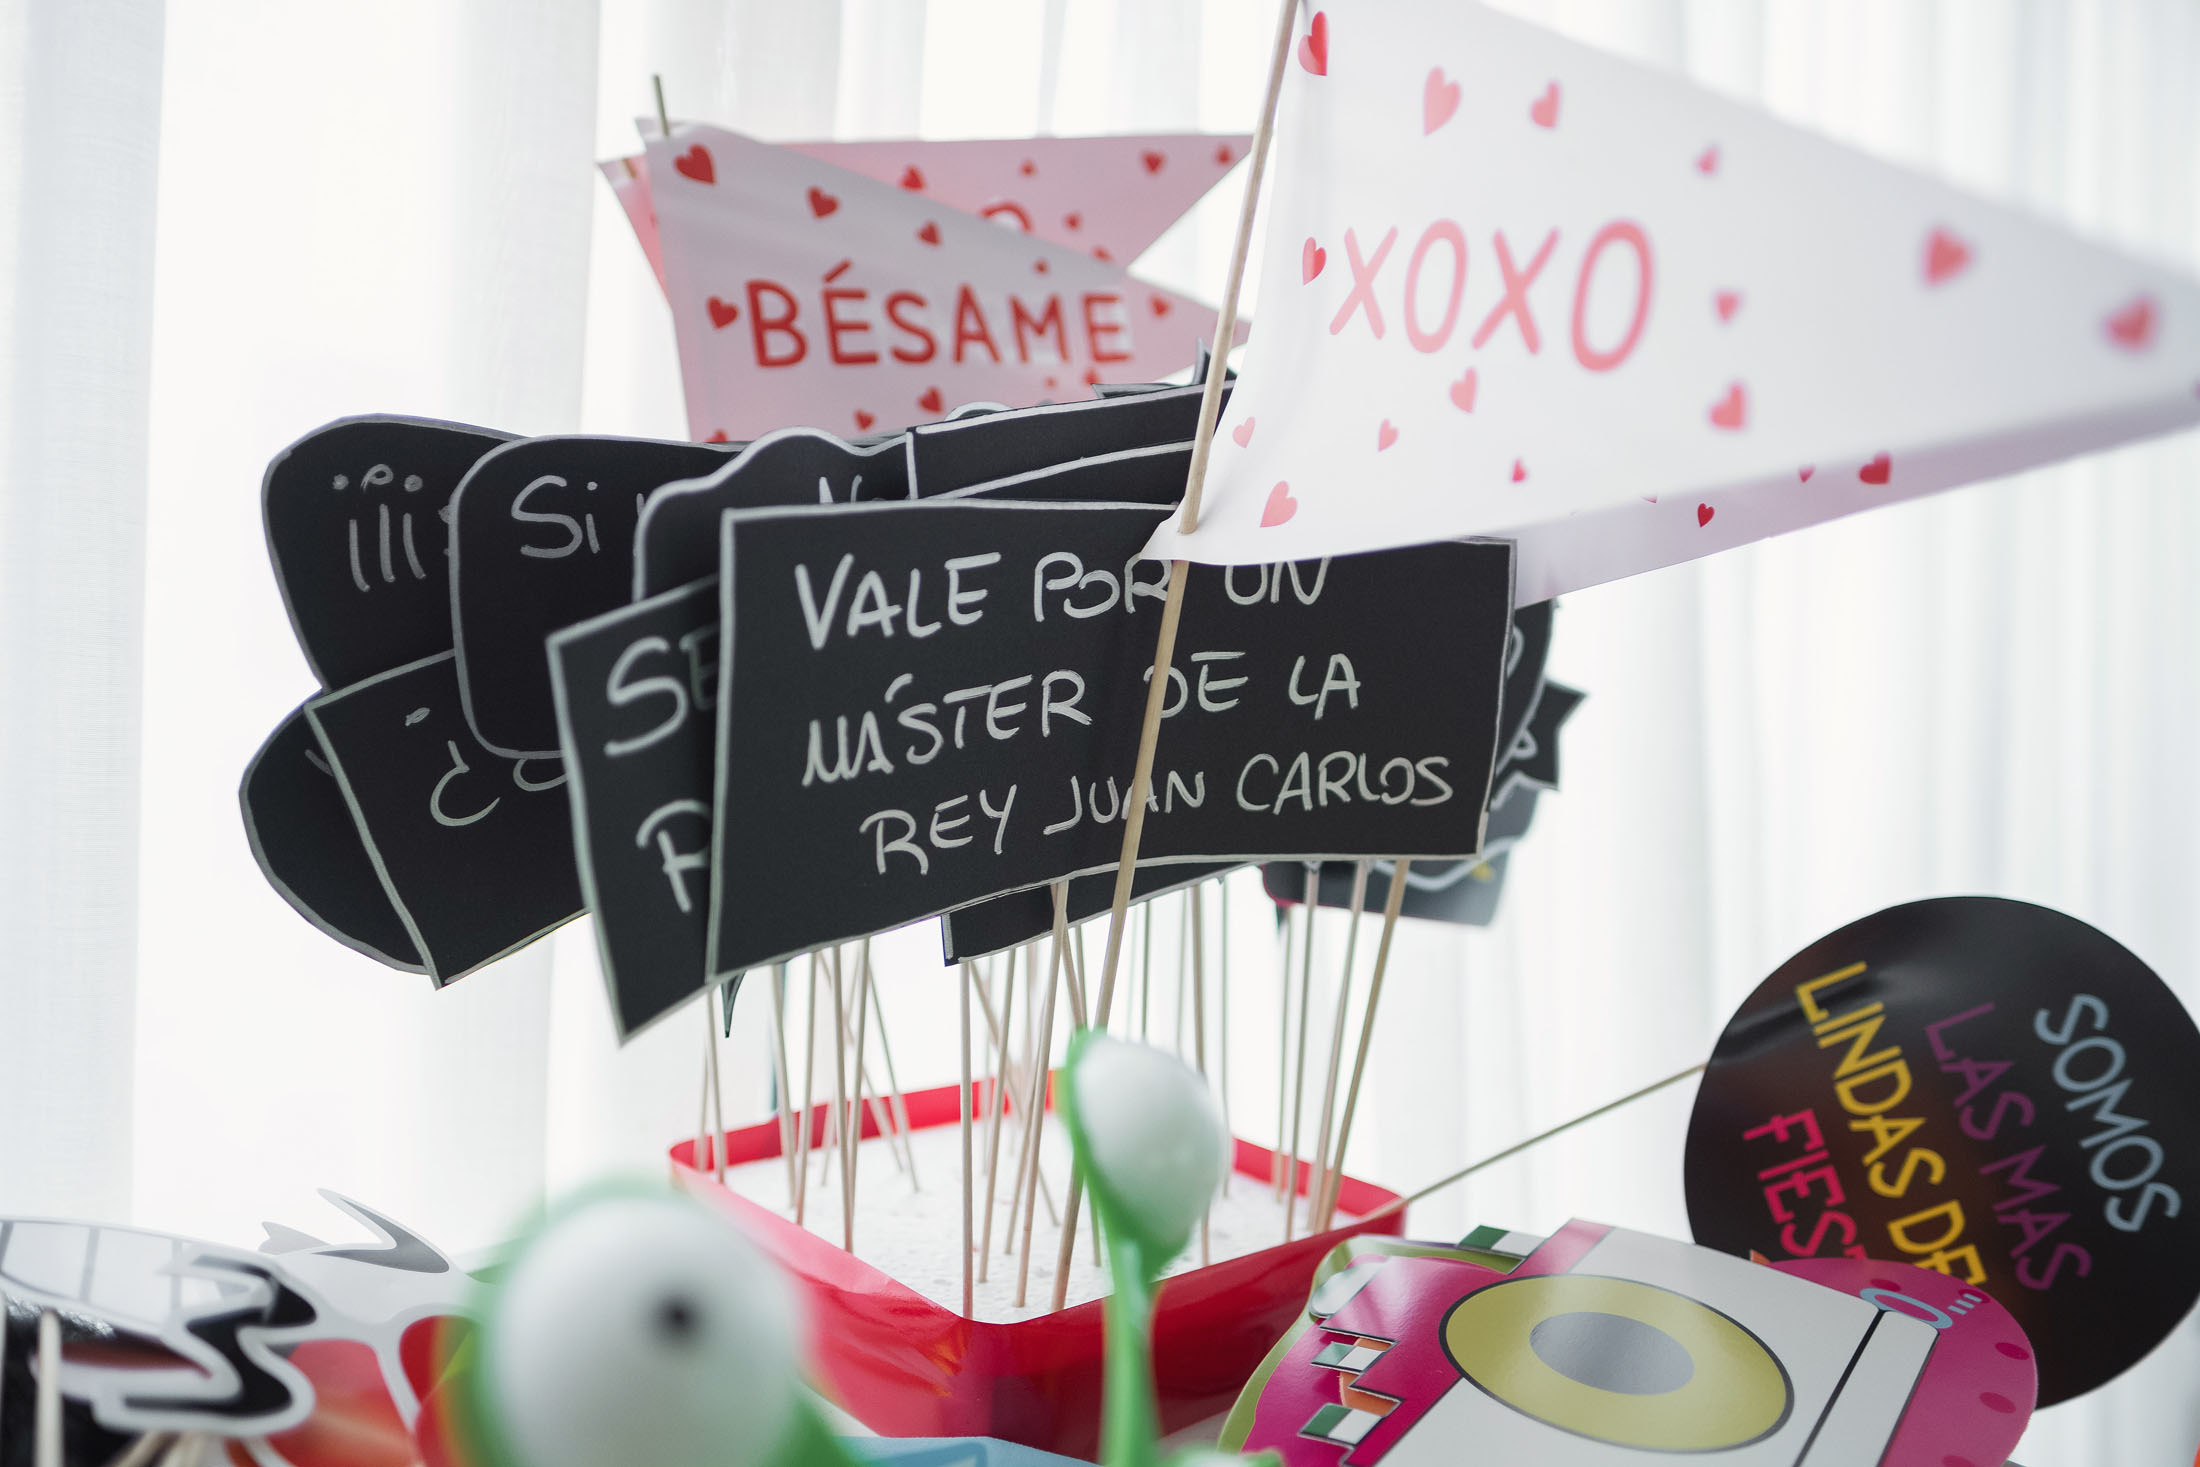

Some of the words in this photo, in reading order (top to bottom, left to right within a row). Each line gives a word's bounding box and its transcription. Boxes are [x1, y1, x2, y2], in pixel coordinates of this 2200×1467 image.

[744, 259, 1133, 369] BÉSAME
[1328, 217, 1655, 374] XOXO
[510, 474, 600, 559] Si
[794, 552, 1001, 650] VALE
[1033, 551, 1175, 622] POR
[1224, 556, 1333, 606] UN
[1143, 651, 1249, 719] DE
[1288, 653, 1362, 721] LA
[859, 784, 1018, 876] REY
[1043, 770, 1206, 836] JUAN
[1236, 750, 1454, 816] CARLOS
[1795, 961, 1947, 1199] LINDAS
[1887, 1199, 1989, 1286] DE
[1926, 1001, 2035, 1140] LAS
[2033, 993, 2182, 1232] SOMOS
[1742, 1108, 1868, 1260] FIES
[1979, 1144, 2092, 1291] MAS
